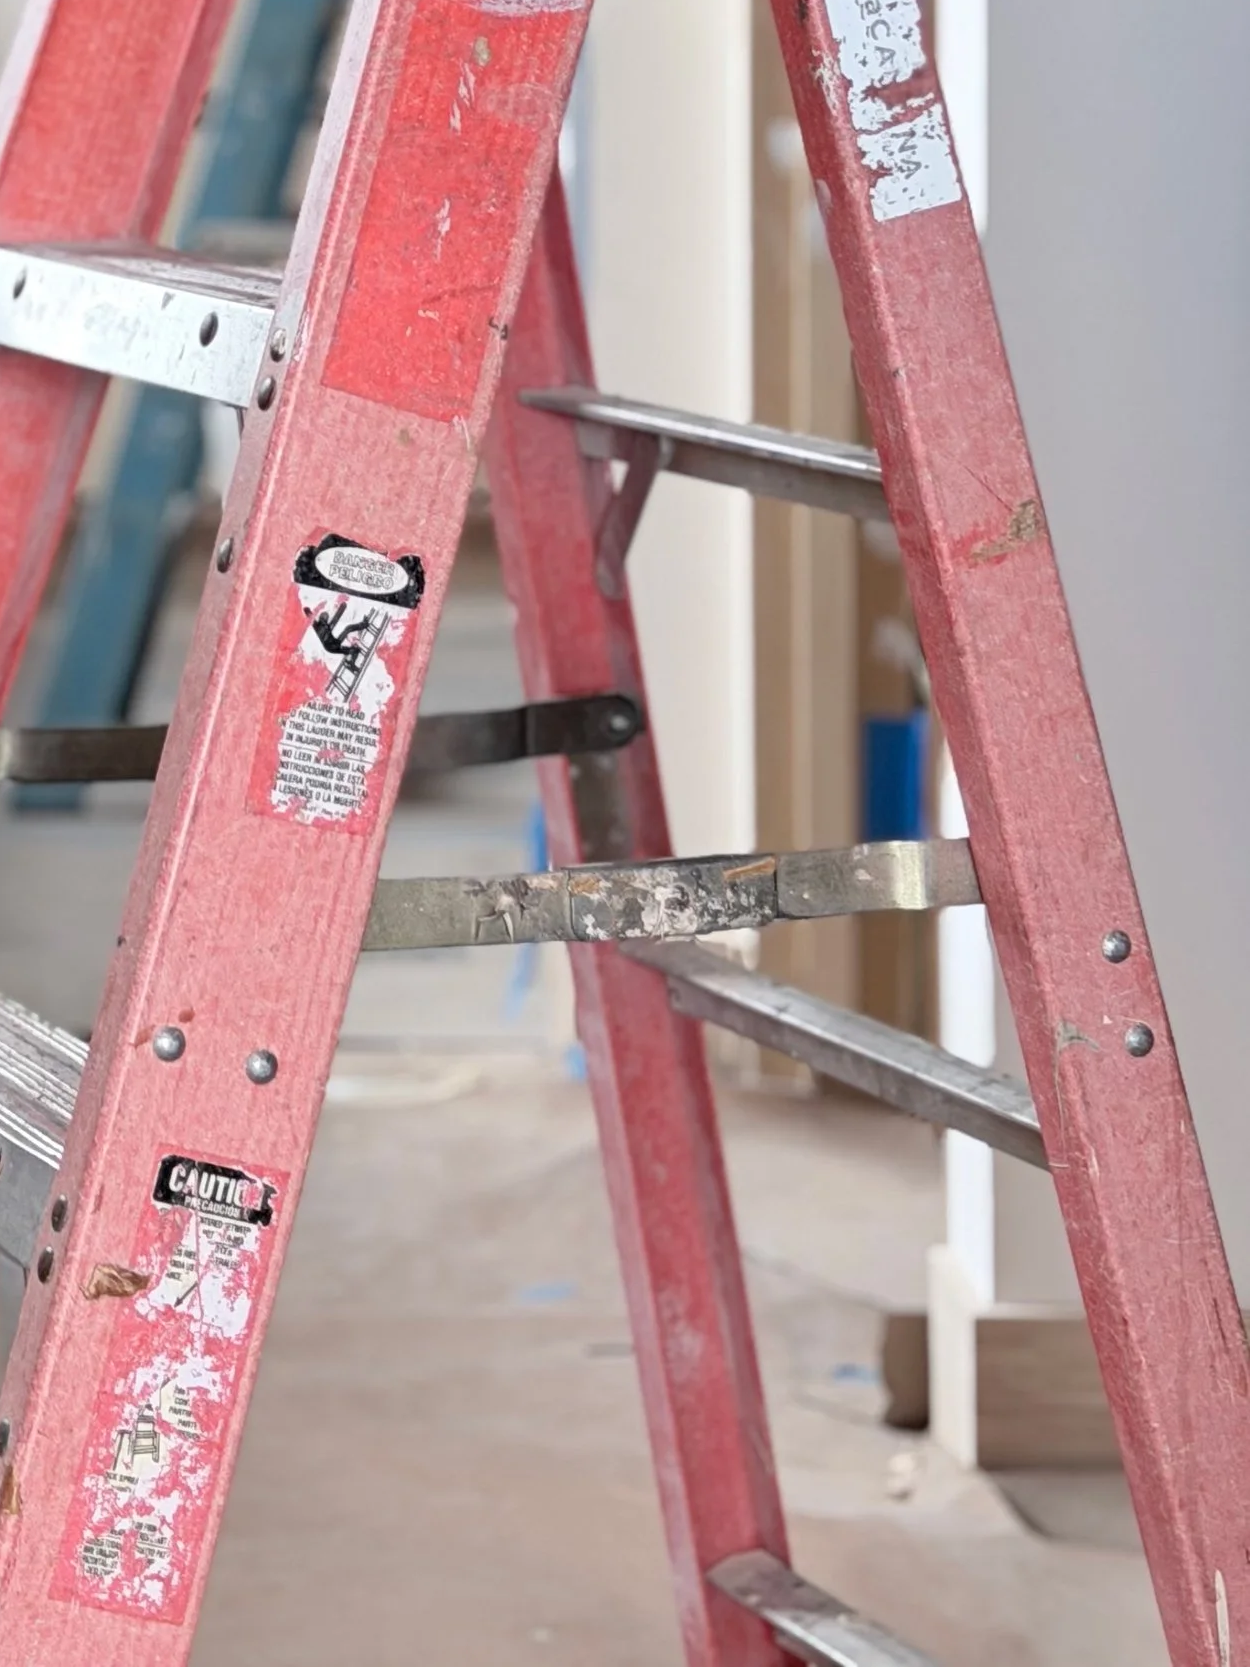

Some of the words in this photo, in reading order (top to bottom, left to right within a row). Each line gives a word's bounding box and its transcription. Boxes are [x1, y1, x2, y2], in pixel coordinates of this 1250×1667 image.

[333, 551, 395, 575] DANGER
[328, 564, 394, 589] PELIGRO
[335, 707, 344, 716] TO
[289, 721, 305, 731] THIS
[306, 725, 335, 739] LADDER
[337, 732, 352, 742] MAY
[298, 710, 328, 725] FOLLOW
[330, 717, 382, 737] INSTRUCTIONS
[286, 732, 294, 740] IN
[296, 733, 327, 748] INJURIES
[330, 741, 341, 751] OR
[282, 749, 292, 757] NO
[294, 751, 312, 762] LEER
[279, 759, 334, 780] NSTRUCCIONES
[336, 773, 345, 781] DE
[347, 775, 365, 786] ESTA
[323, 794, 332, 802] LA
